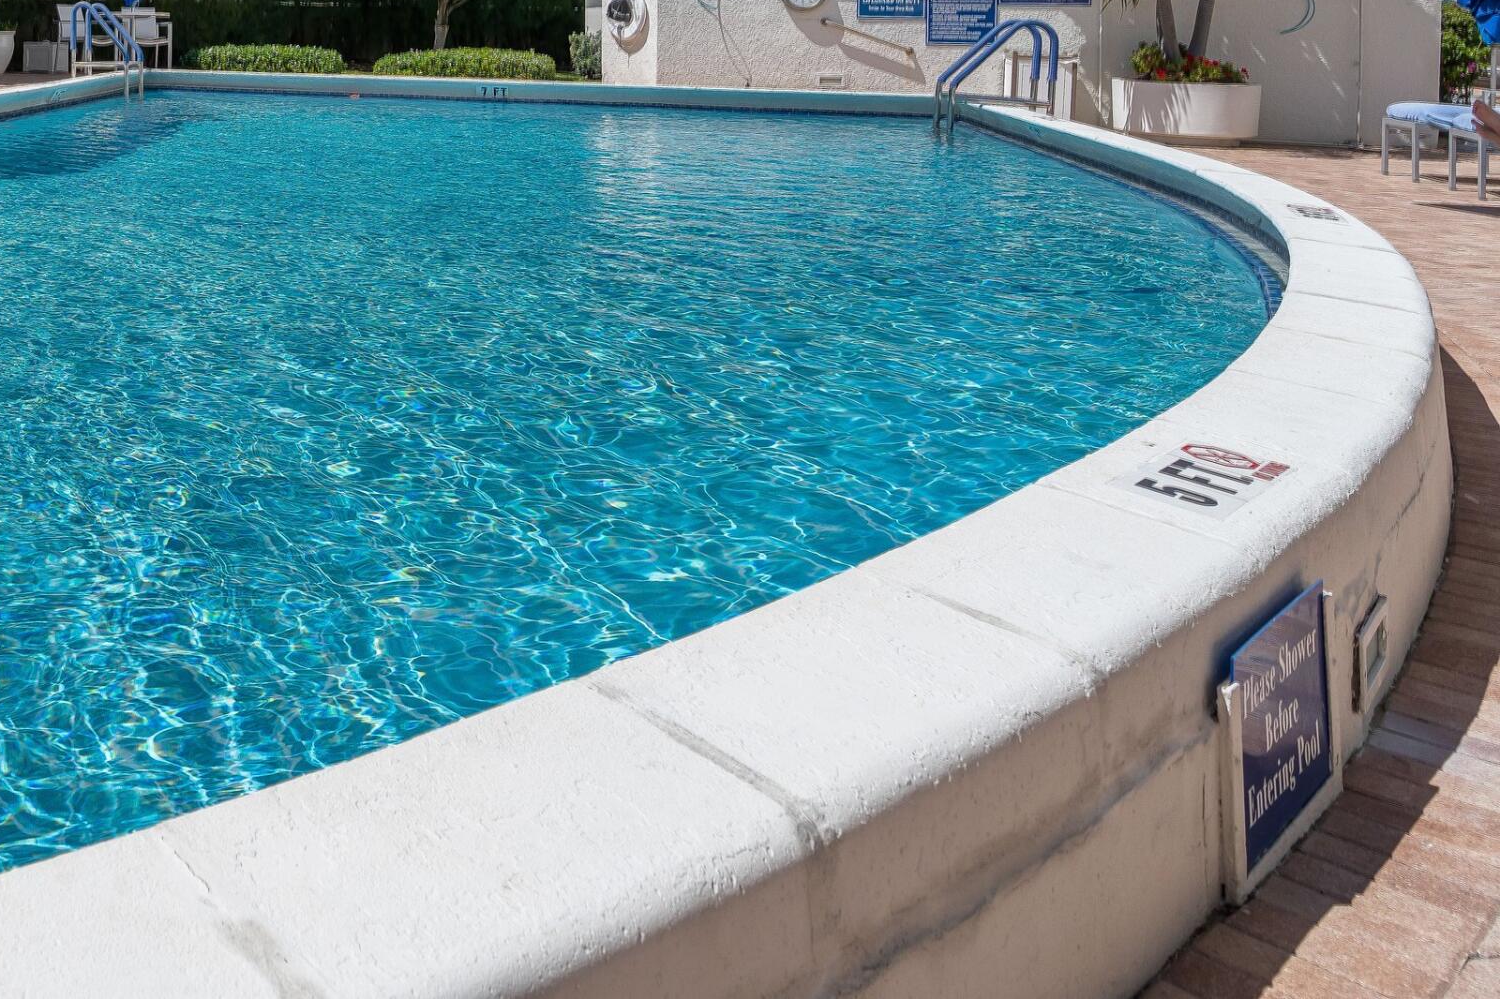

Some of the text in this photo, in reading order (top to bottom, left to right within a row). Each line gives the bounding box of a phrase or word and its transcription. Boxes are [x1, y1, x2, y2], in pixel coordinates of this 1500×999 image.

[481, 86, 508, 97] 7 FT
[1134, 476, 1218, 507] 5
[1243, 628, 1317, 720] Please Shower
[1265, 697, 1299, 753] Before
[1248, 719, 1321, 829] Entering Pool
